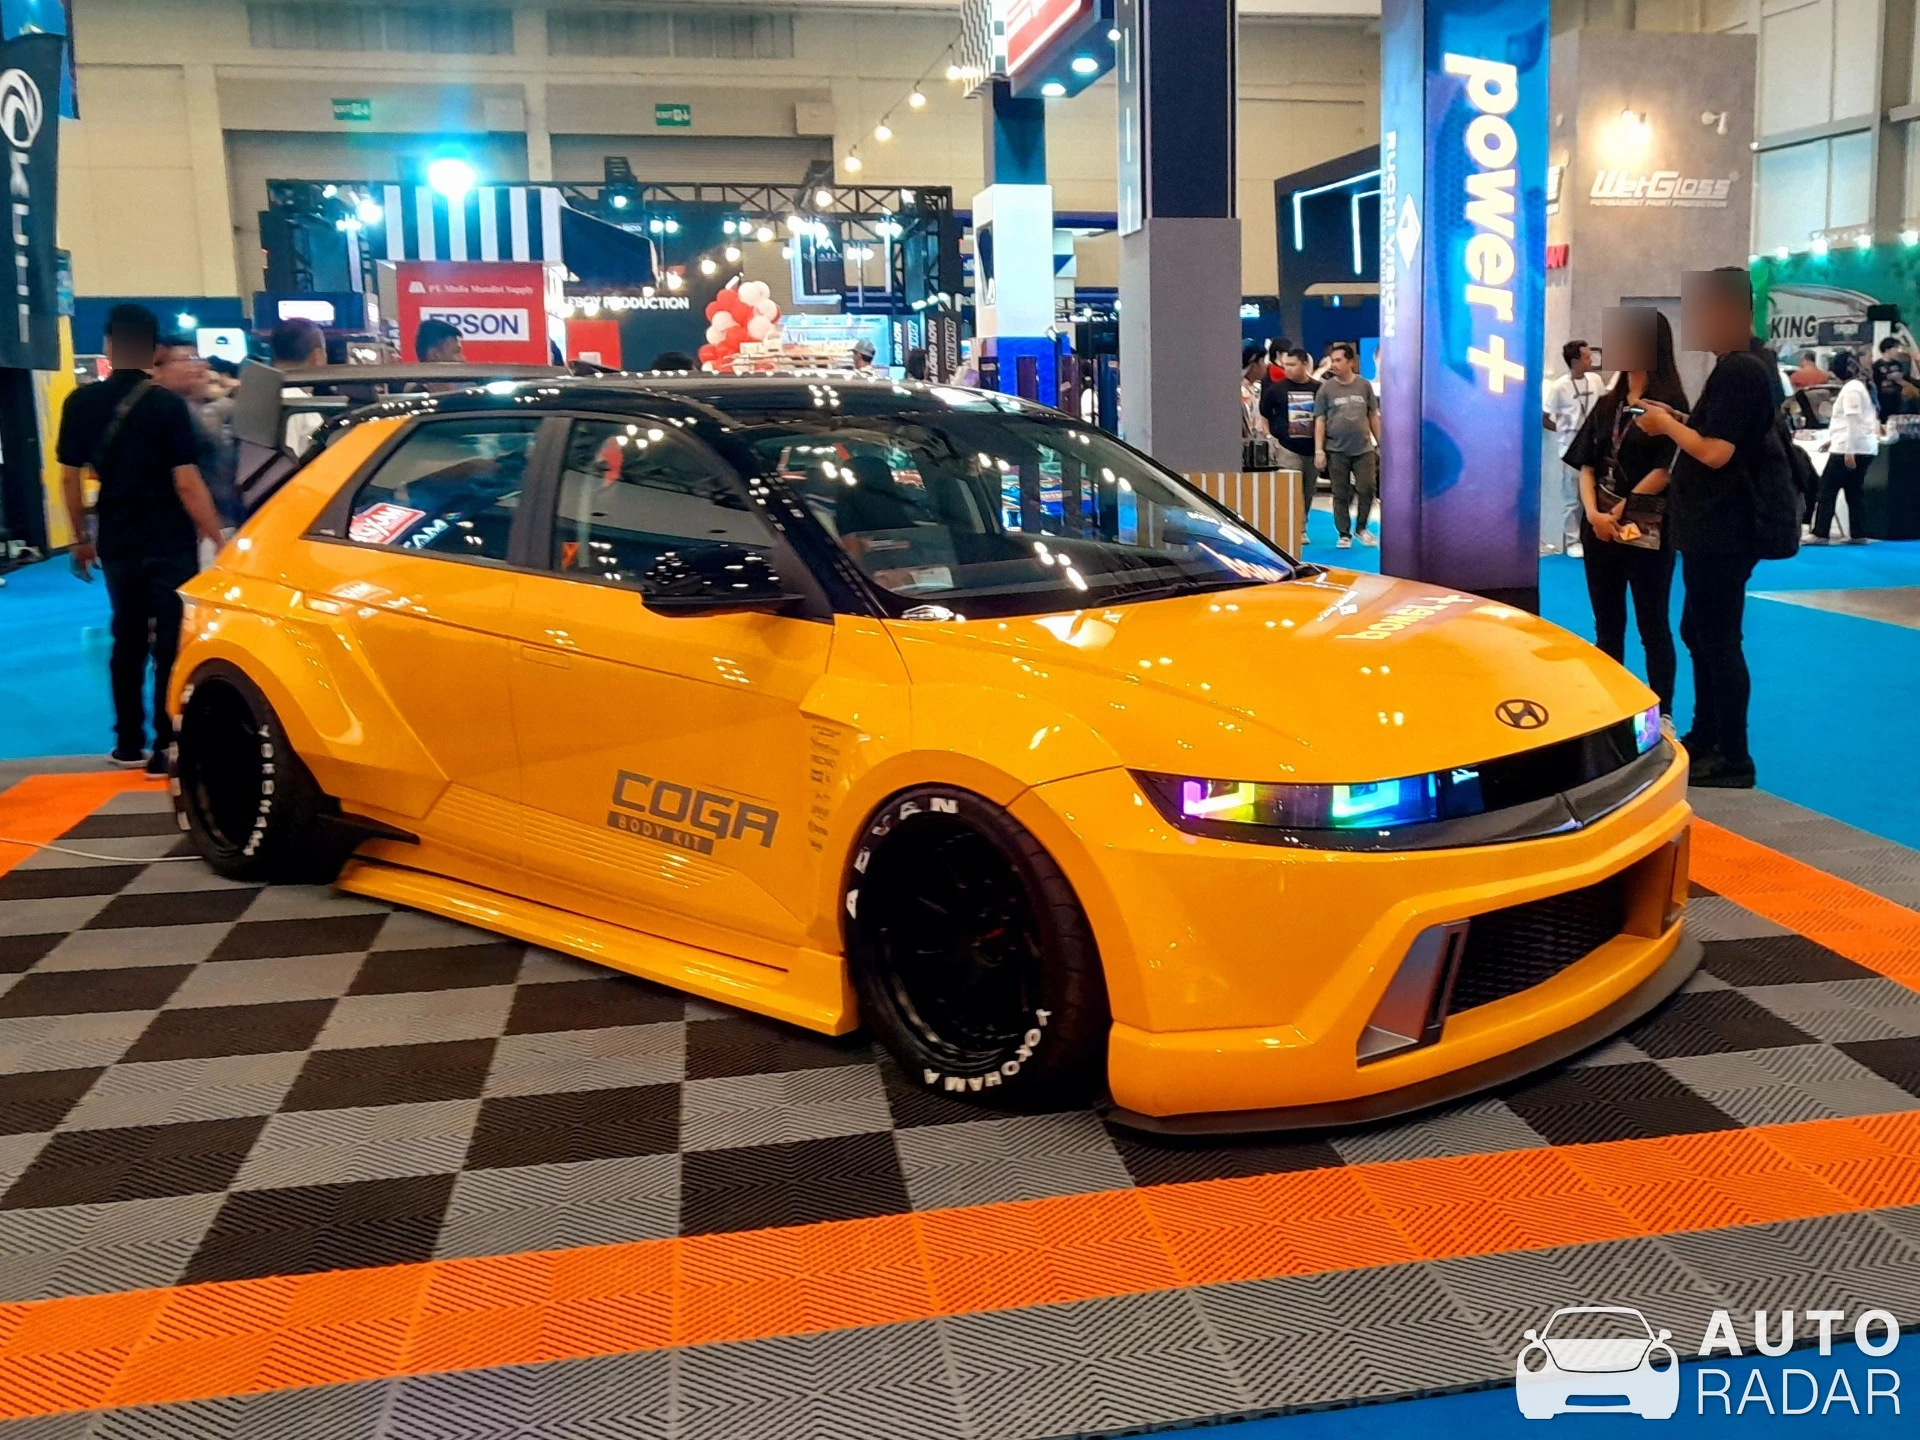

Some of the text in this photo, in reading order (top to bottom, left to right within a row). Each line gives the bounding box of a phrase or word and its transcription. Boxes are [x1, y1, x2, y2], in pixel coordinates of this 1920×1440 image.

[1384, 131, 1396, 337] RUCHI VISION
[1770, 315, 1817, 339] KING
[612, 769, 779, 849] COGA
[617, 815, 700, 851] BODY KIT
[923, 1008, 1053, 1092] YOKOHAMA
